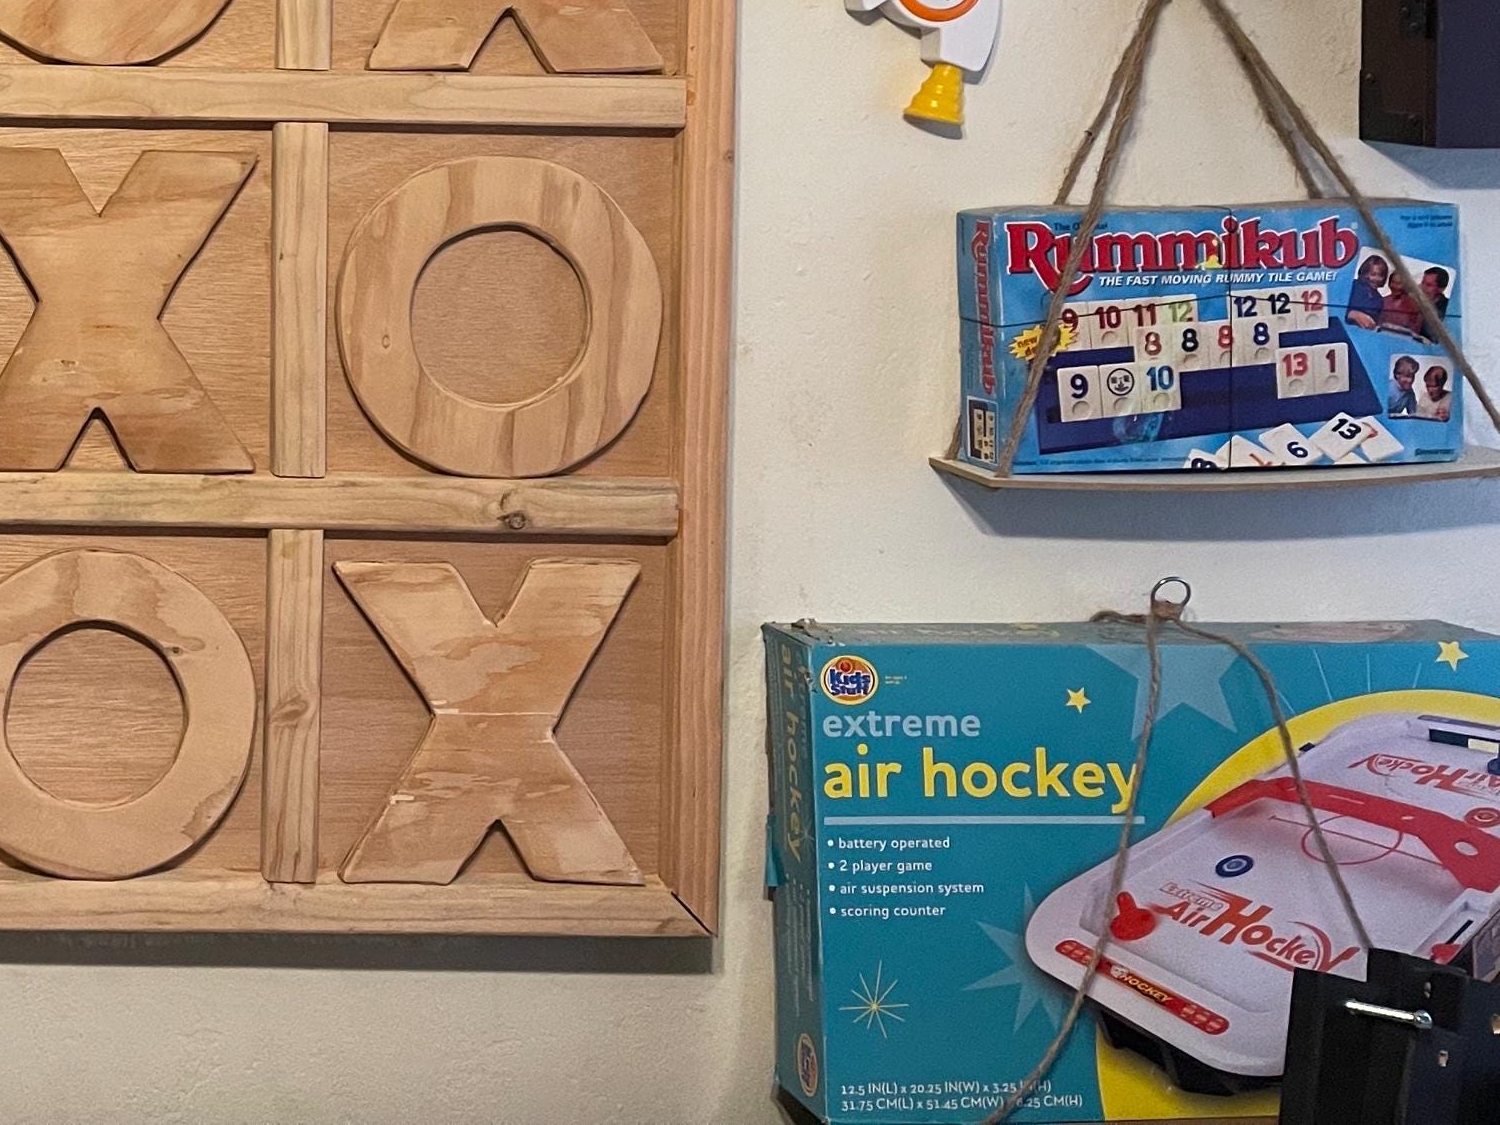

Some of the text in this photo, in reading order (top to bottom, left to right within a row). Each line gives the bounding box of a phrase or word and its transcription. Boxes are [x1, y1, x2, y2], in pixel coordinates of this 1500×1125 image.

[1004, 214, 1360, 297] Rummikub
[1099, 271, 1338, 287] THE FAST MOVING RUMMY TILE GAME!
[1097, 289, 1324, 329] 10 11 12 12 12 12
[1144, 321, 1270, 356] 8 8 8 8
[1282, 348, 1337, 377] 13 1
[1070, 364, 1175, 399] 9 10
[1331, 417, 1362, 441] 13
[829, 668, 871, 688] Kids
[822, 709, 982, 739] extreme
[823, 743, 1138, 815] air hockey
[838, 836, 950, 852] battery operated
[839, 859, 933, 875] 2 player game
[840, 881, 985, 897] air suspension system
[841, 904, 946, 920] scoring counter
[1155, 900, 1211, 927] Air
[1121, 971, 1174, 1003] HOCKEY
[841, 1080, 1017, 1096] 12.5 IN(L) 20.25 IN(W) 3.25
[841, 1094, 1083, 1111] 31.75 CM(L) 51.45 CM(W) CM(H)
